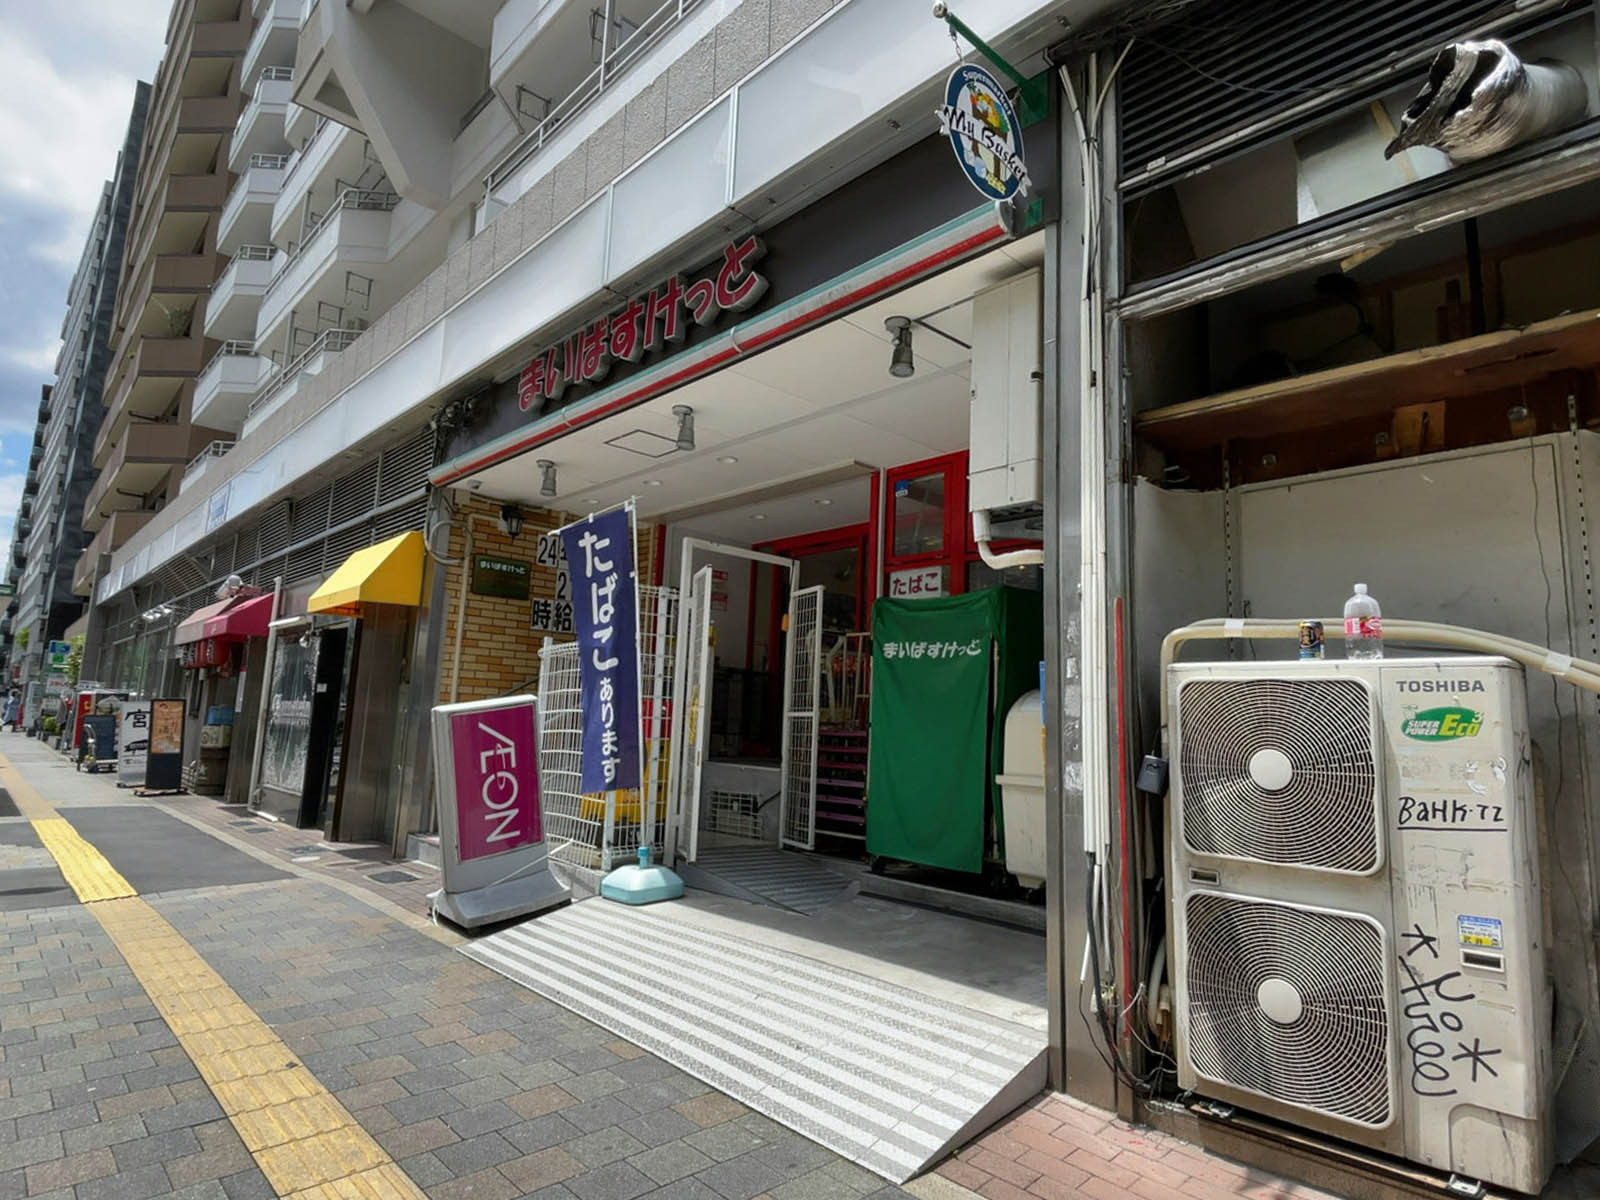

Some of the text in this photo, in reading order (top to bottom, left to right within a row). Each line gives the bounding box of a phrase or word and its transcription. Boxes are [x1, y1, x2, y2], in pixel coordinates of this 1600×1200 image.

[944, 106, 975, 141] My
[518, 235, 767, 411] まいばすけっと
[892, 572, 940, 596] たばこ
[532, 600, 573, 632] 時給
[882, 639, 982, 659] まいばすけっと
[1396, 680, 1485, 692] TOSHIBA
[1405, 727, 1439, 736] POWER
[1439, 713, 1481, 737] Eco
[1407, 719, 1440, 729] SUPER
